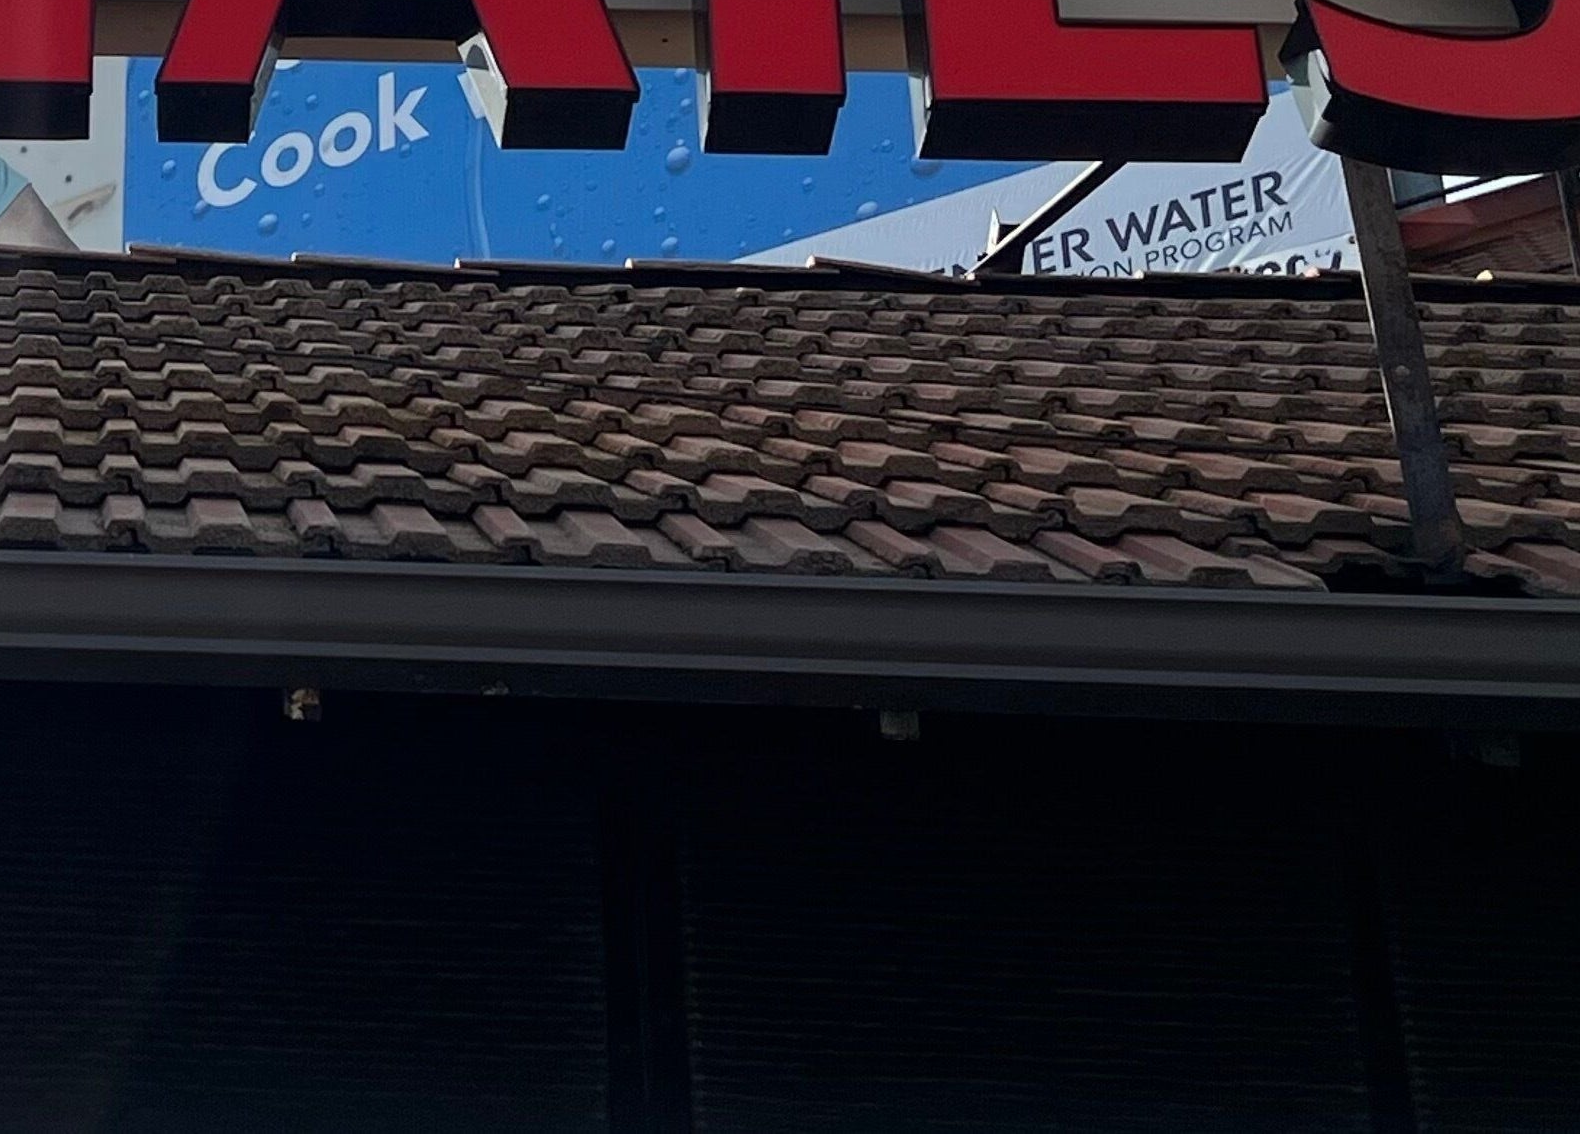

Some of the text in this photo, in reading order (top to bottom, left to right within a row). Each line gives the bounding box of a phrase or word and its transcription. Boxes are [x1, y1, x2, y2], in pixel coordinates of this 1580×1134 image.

[196, 71, 430, 207] Cook
[1105, 170, 1289, 253] WATER
[1144, 210, 1294, 271] PROGRAM
